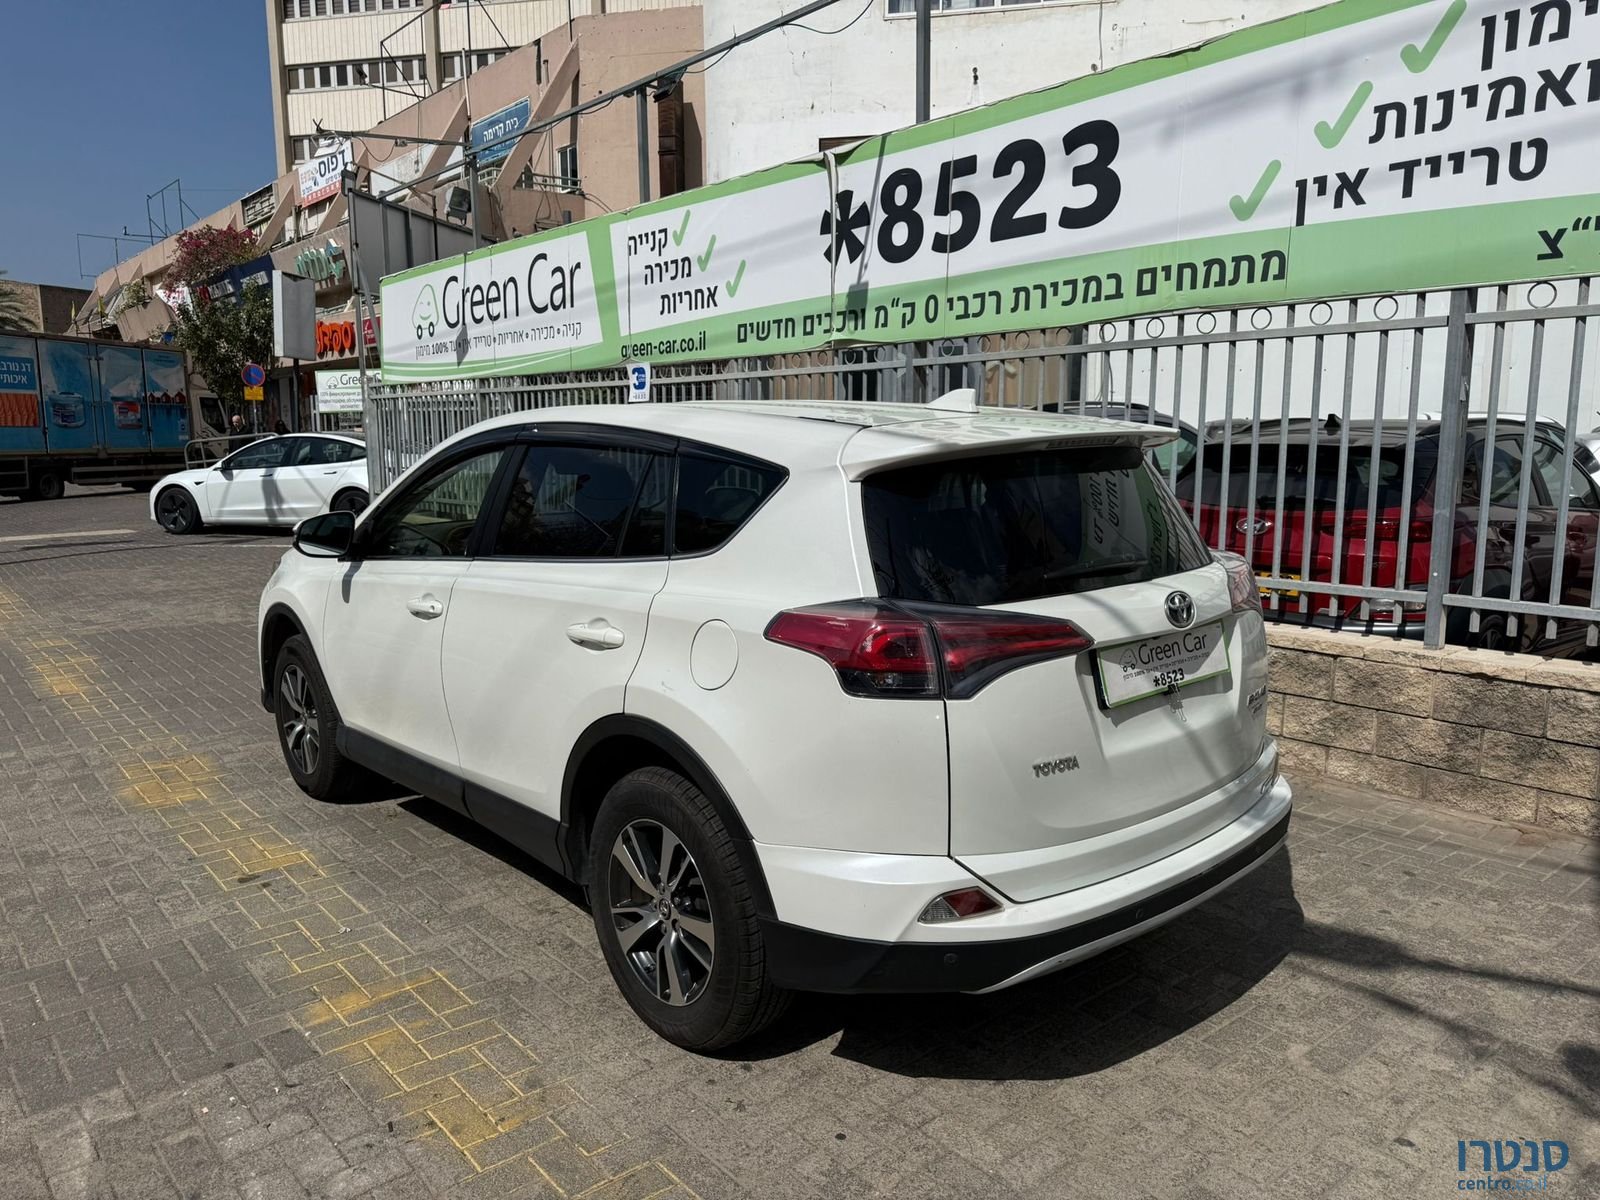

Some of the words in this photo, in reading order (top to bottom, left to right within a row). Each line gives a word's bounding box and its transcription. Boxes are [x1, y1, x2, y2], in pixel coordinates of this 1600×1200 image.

[1368, 58, 1600, 145] ואמינות
[1388, 137, 1549, 199] טרייד
[1294, 167, 1370, 227] אין
[628, 227, 668, 257] קנייה
[644, 256, 692, 286] מכירה
[1136, 250, 1287, 298] מתמחים
[442, 275, 519, 329] Green
[528, 253, 581, 314] Car
[660, 285, 718, 315] אחריות
[946, 291, 1002, 321] רכבי
[1010, 273, 1124, 314] במכירת
[802, 308, 866, 337] ורכבים
[924, 294, 939, 324] 0
[473, 334, 492, 349] טרייד
[497, 330, 524, 346] אחריות
[530, 325, 555, 341] מכירה
[562, 322, 582, 340] קניה
[737, 317, 796, 344] חדשים
[431, 341, 449, 355] 100%
[1138, 641, 1181, 665] Green
[1183, 632, 1207, 653] Car
[1032, 755, 1080, 778] TOYOTA
